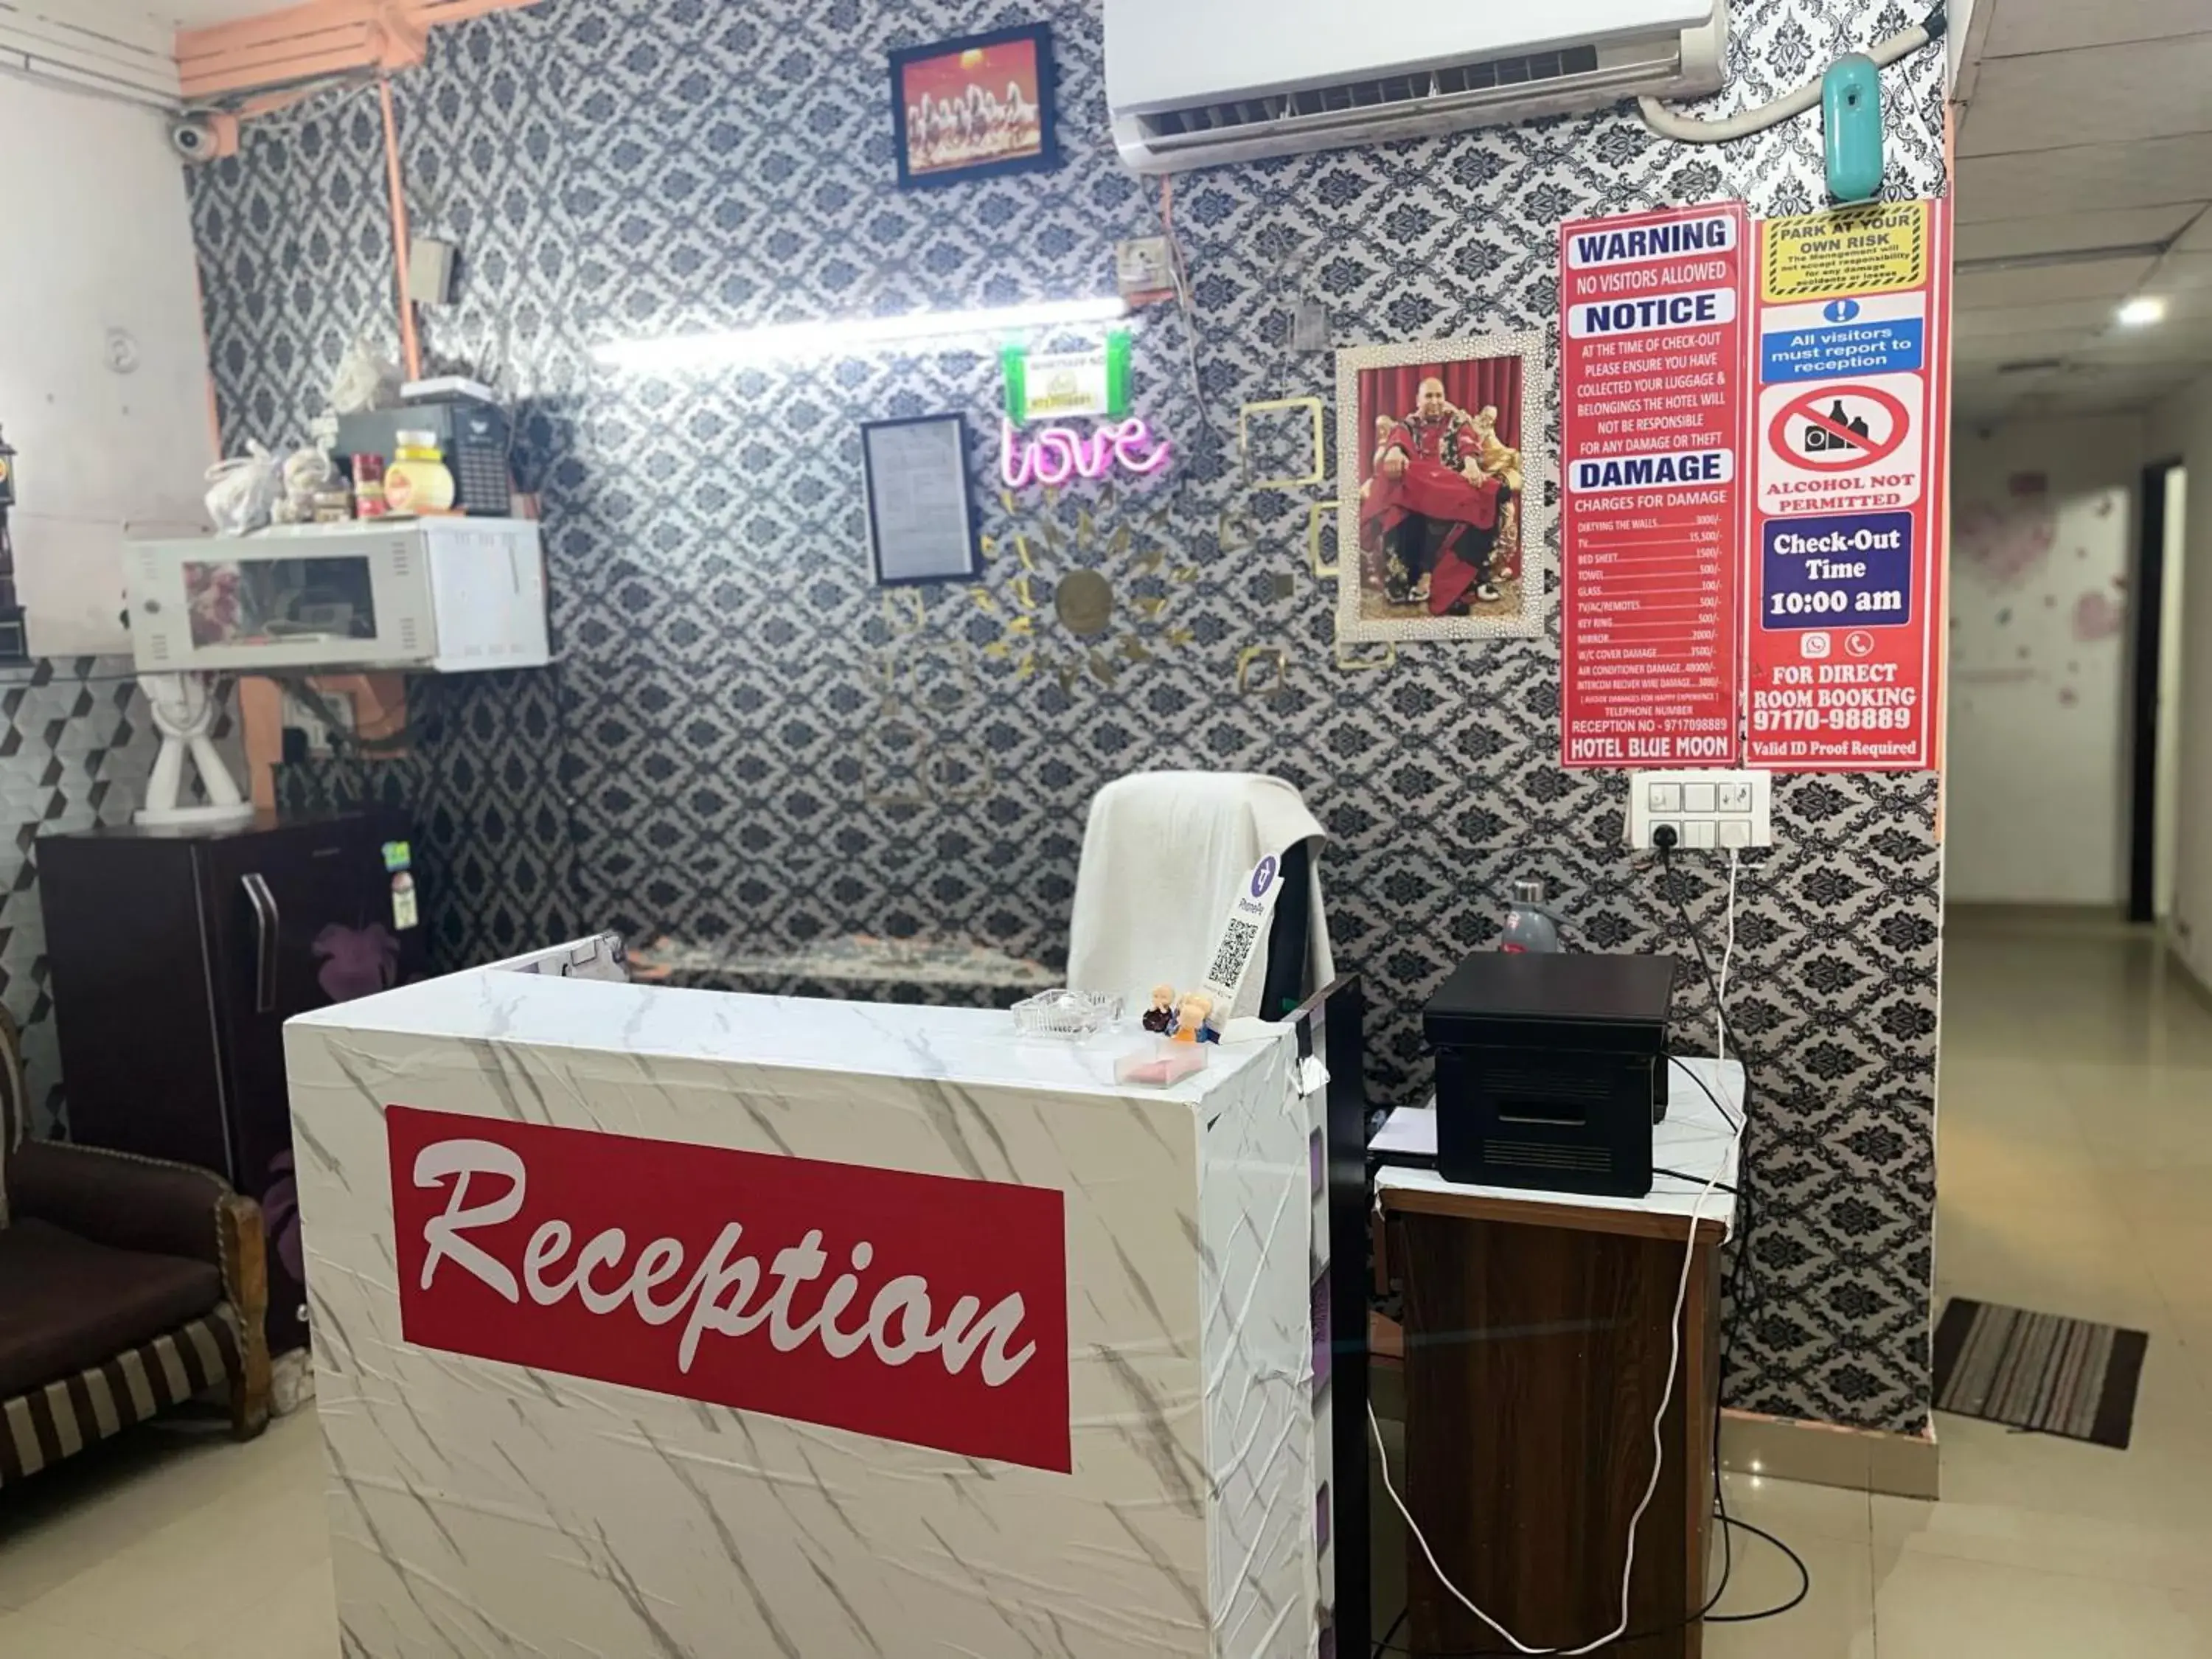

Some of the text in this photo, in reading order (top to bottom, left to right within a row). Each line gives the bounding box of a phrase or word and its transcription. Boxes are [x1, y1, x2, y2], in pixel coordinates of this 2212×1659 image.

[1781, 215, 1910, 240] PARK AT YOUR
[1578, 220, 1725, 263] WARNING
[1801, 233, 1890, 254] OWN RISK
[1801, 261, 1835, 270] accept
[1839, 252, 1910, 266] responsibility
[1810, 247, 1877, 261] Management
[1577, 260, 1726, 295] NO VISITORS ALLOWED
[1844, 264, 1885, 273] damage
[1796, 276, 1846, 286] accidents
[1587, 293, 1716, 333] NOTICE
[1582, 333, 1722, 358] AT THE TIME OF CHECK-OUT
[1790, 328, 1893, 347] All visitors
[1772, 339, 1911, 361] must report to
[1585, 352, 1717, 378] PLEASE ENSURE YOU HAVE
[1794, 355, 1887, 372] reception
[1577, 372, 1725, 397] COLLECTED YOUR LUGGAGE &
[1578, 392, 1725, 417] BELONGINGS THE HOTEL WILL
[1598, 414, 1704, 434] NOT BE RESPONSIBLE
[1001, 417, 1171, 487] love
[1580, 432, 1722, 455] FOR ANY DAMAGE OR THEFT
[1580, 454, 1721, 488] DAMAGE
[1766, 474, 1915, 495] ALCOHOL NOT
[1575, 490, 1728, 513] CHARGES FOR DAMAGE
[1779, 493, 1901, 512] PERMITTED
[1616, 520, 1632, 531] THE
[1632, 518, 1658, 529] WALLS
[1773, 529, 1901, 554] Check-Out
[1578, 554, 1593, 565] BED
[1595, 553, 1618, 563] SHEET
[1806, 559, 1866, 580] Time
[1578, 587, 1601, 597] GLASS
[1770, 590, 1902, 615] 10:00 am
[1578, 619, 1592, 628] KEY
[1594, 618, 1613, 627] RING
[1596, 650, 1621, 659] COVER
[1624, 648, 1658, 658] DAMAGE
[1578, 666, 1590, 675] AIR
[1593, 664, 1645, 675] CONDITIONER
[1647, 663, 1680, 673] DAMAGE
[1773, 663, 1898, 685] FOR DIRECT
[1577, 679, 1611, 690] INTERCOM
[1660, 676, 1691, 688] DAMAGE
[1753, 687, 1916, 709] ROOM BOOKING
[1604, 706, 1693, 717] TELEPHONE NUMBER
[1753, 708, 1910, 731] 97170-98889
[1572, 720, 1635, 733] RECEPTION
[1638, 721, 1655, 731] NO
[1664, 718, 1727, 731] 9717098889
[1572, 736, 1728, 760] HOTEL BLUE MOON
[1751, 740, 1916, 758] Valid ID Proof Required
[412, 1138, 1037, 1387] Reception
